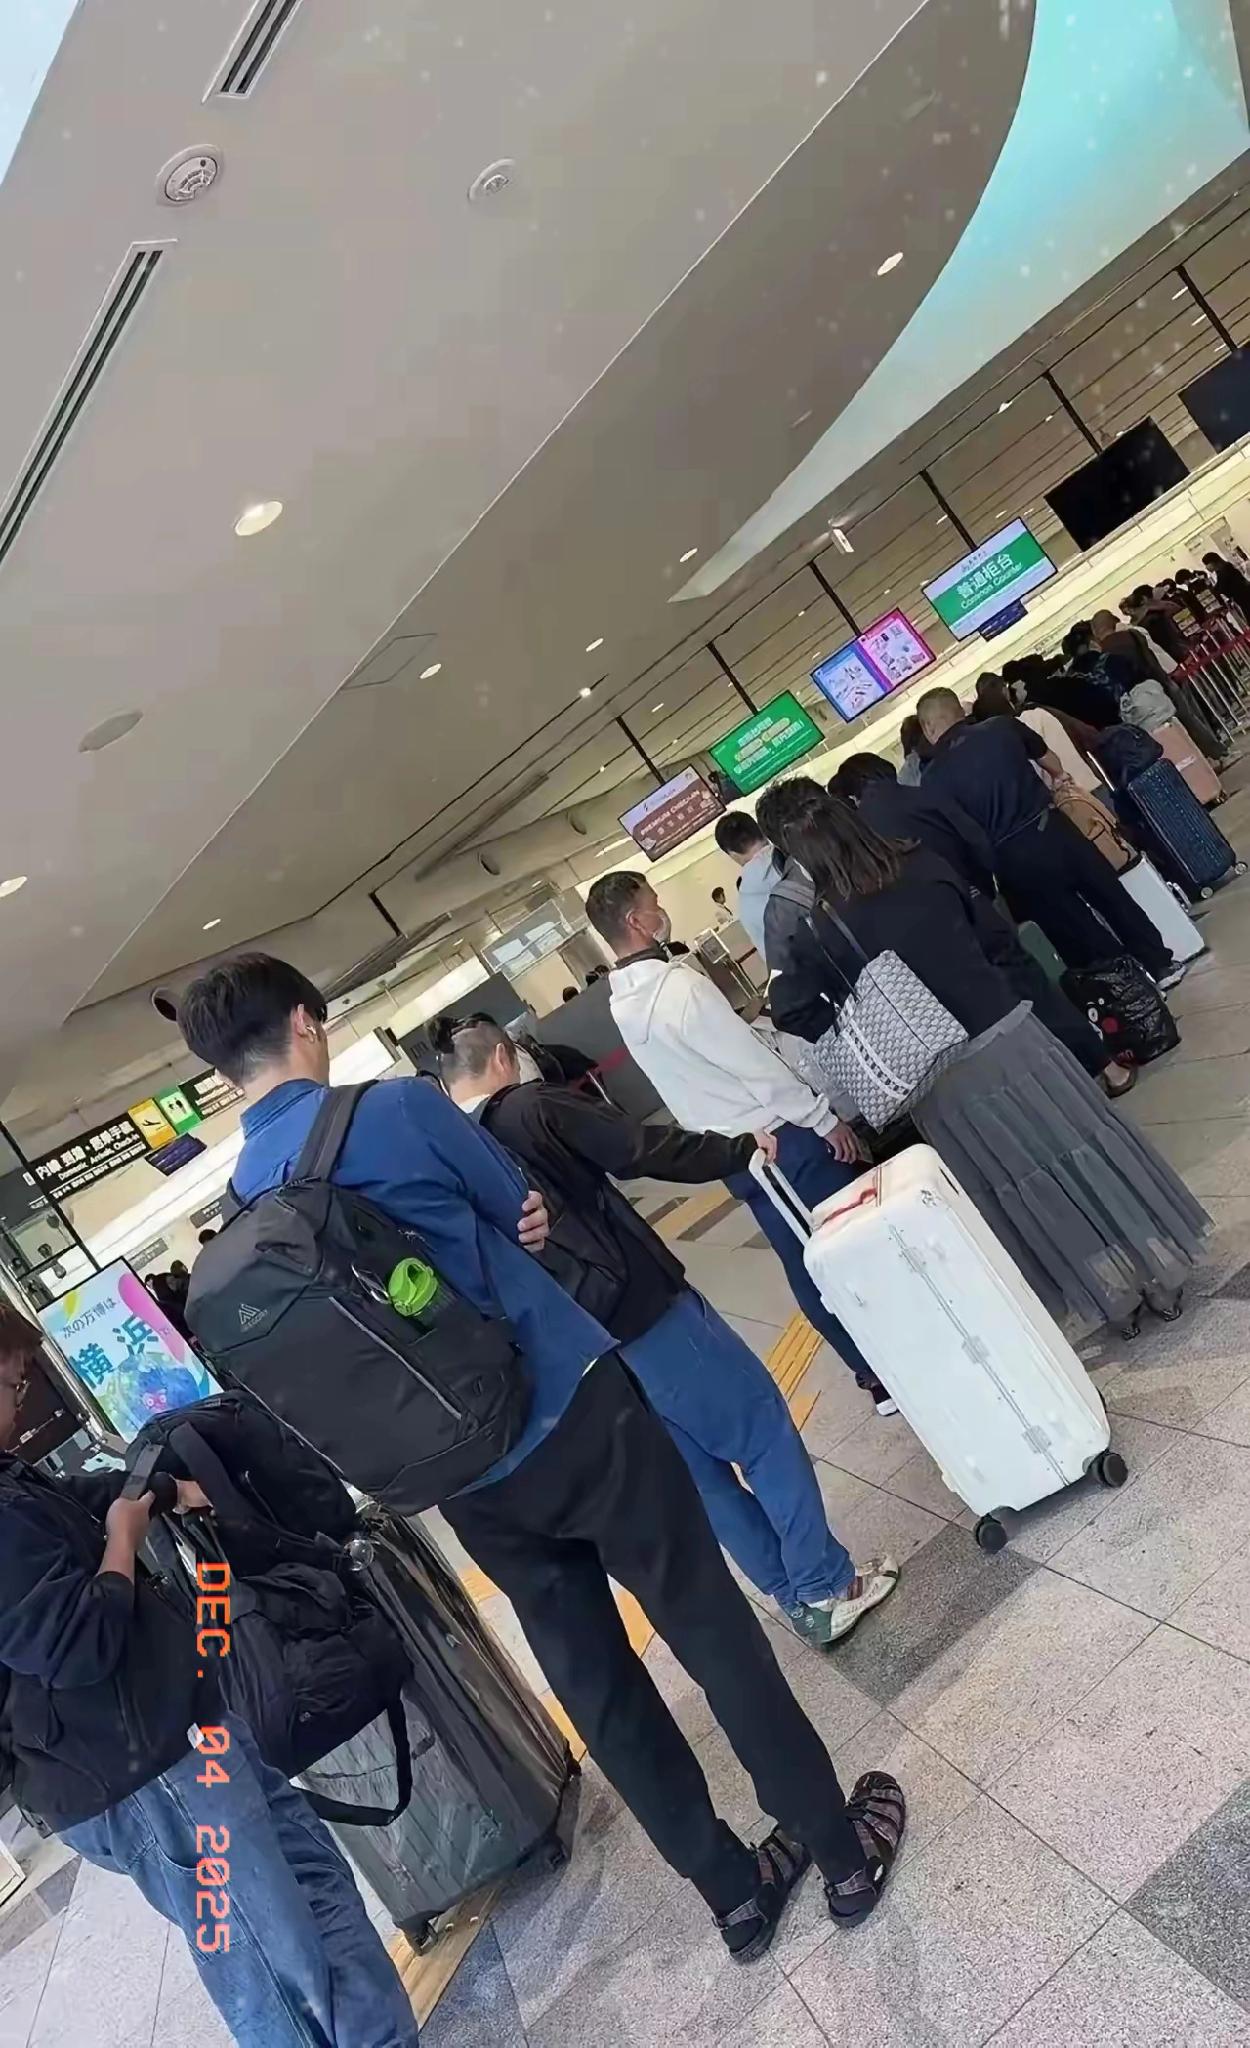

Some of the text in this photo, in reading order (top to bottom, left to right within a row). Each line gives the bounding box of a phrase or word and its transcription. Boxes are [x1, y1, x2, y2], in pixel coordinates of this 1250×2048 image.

[62, 1297, 118, 1339] 次の万博は
[69, 1312, 159, 1389] 横浜
